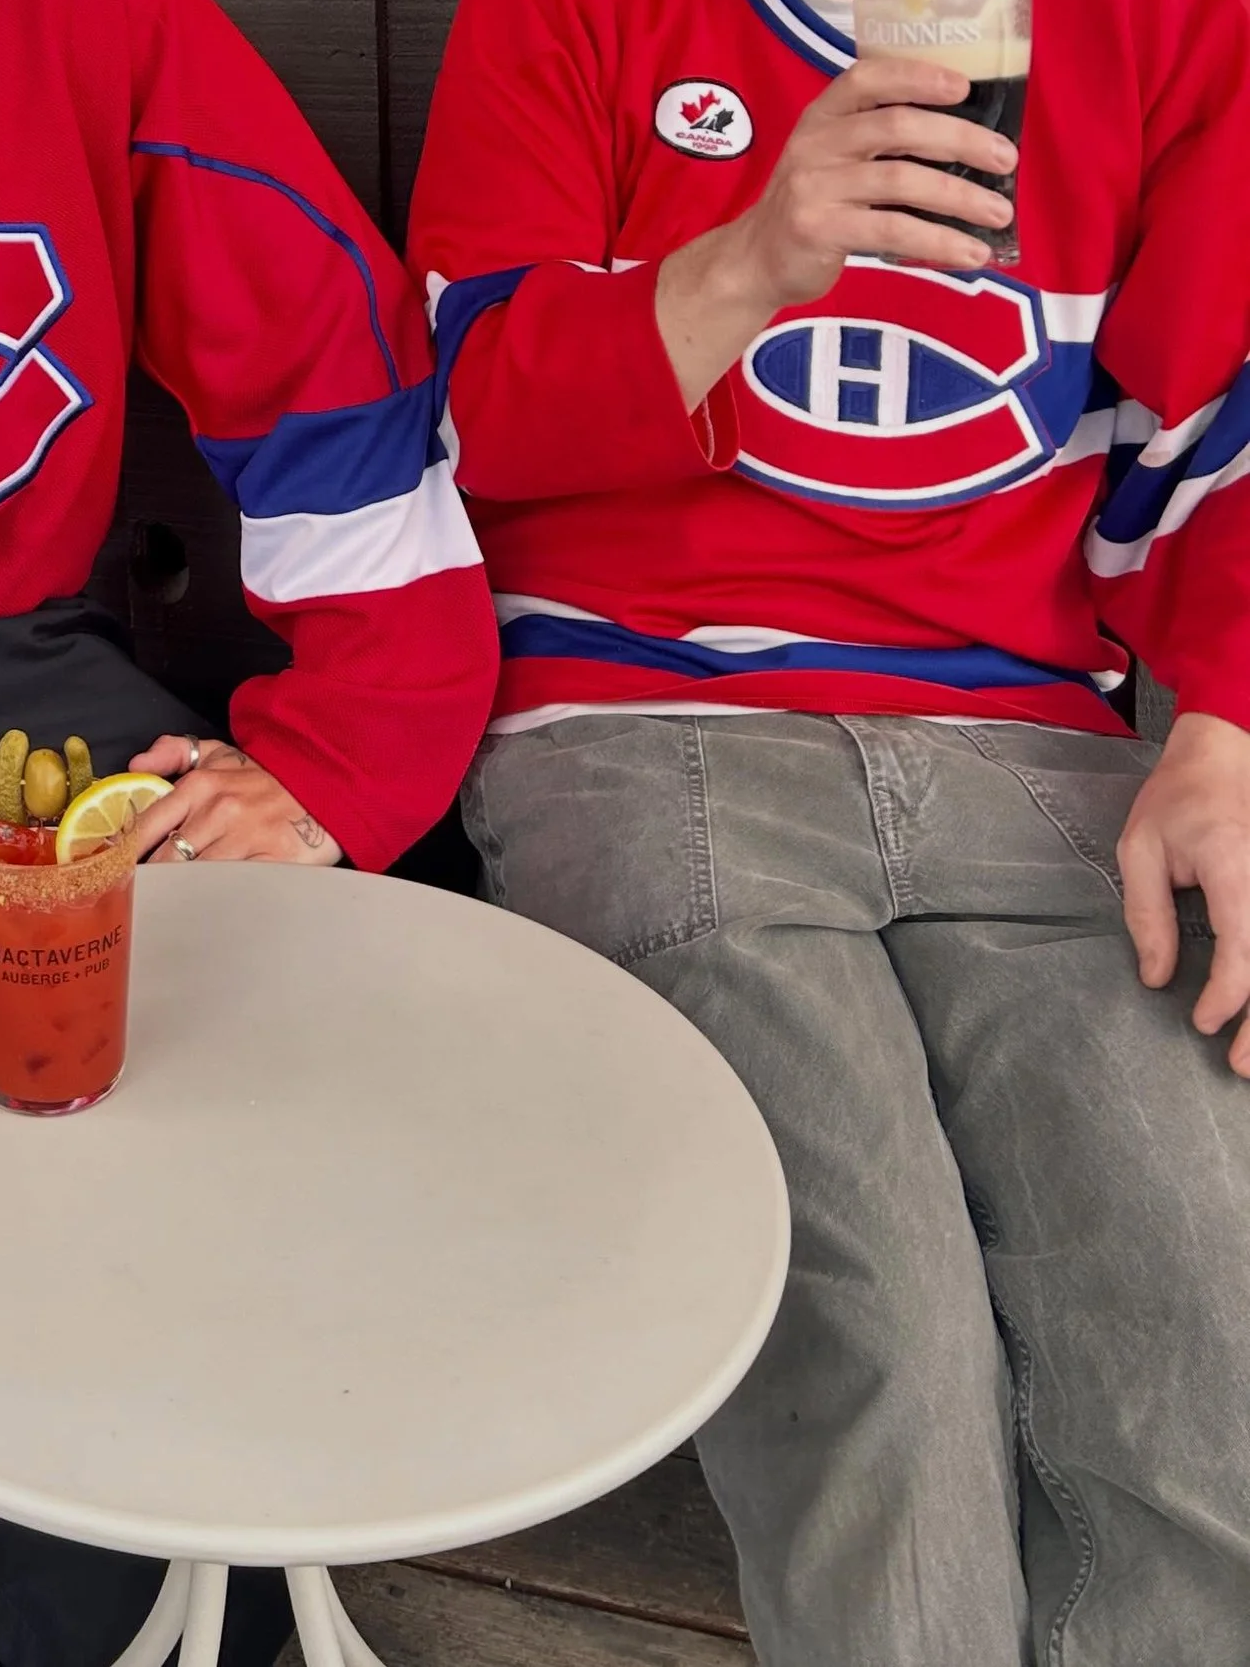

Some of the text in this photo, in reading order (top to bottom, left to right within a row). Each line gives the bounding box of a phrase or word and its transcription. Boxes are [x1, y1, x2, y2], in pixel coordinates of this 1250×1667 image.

[864, 18, 982, 46] GUINNESS
[675, 132, 733, 147] CANADA
[1, 971, 70, 985] AUBERGE
[85, 958, 110, 978] PUB
